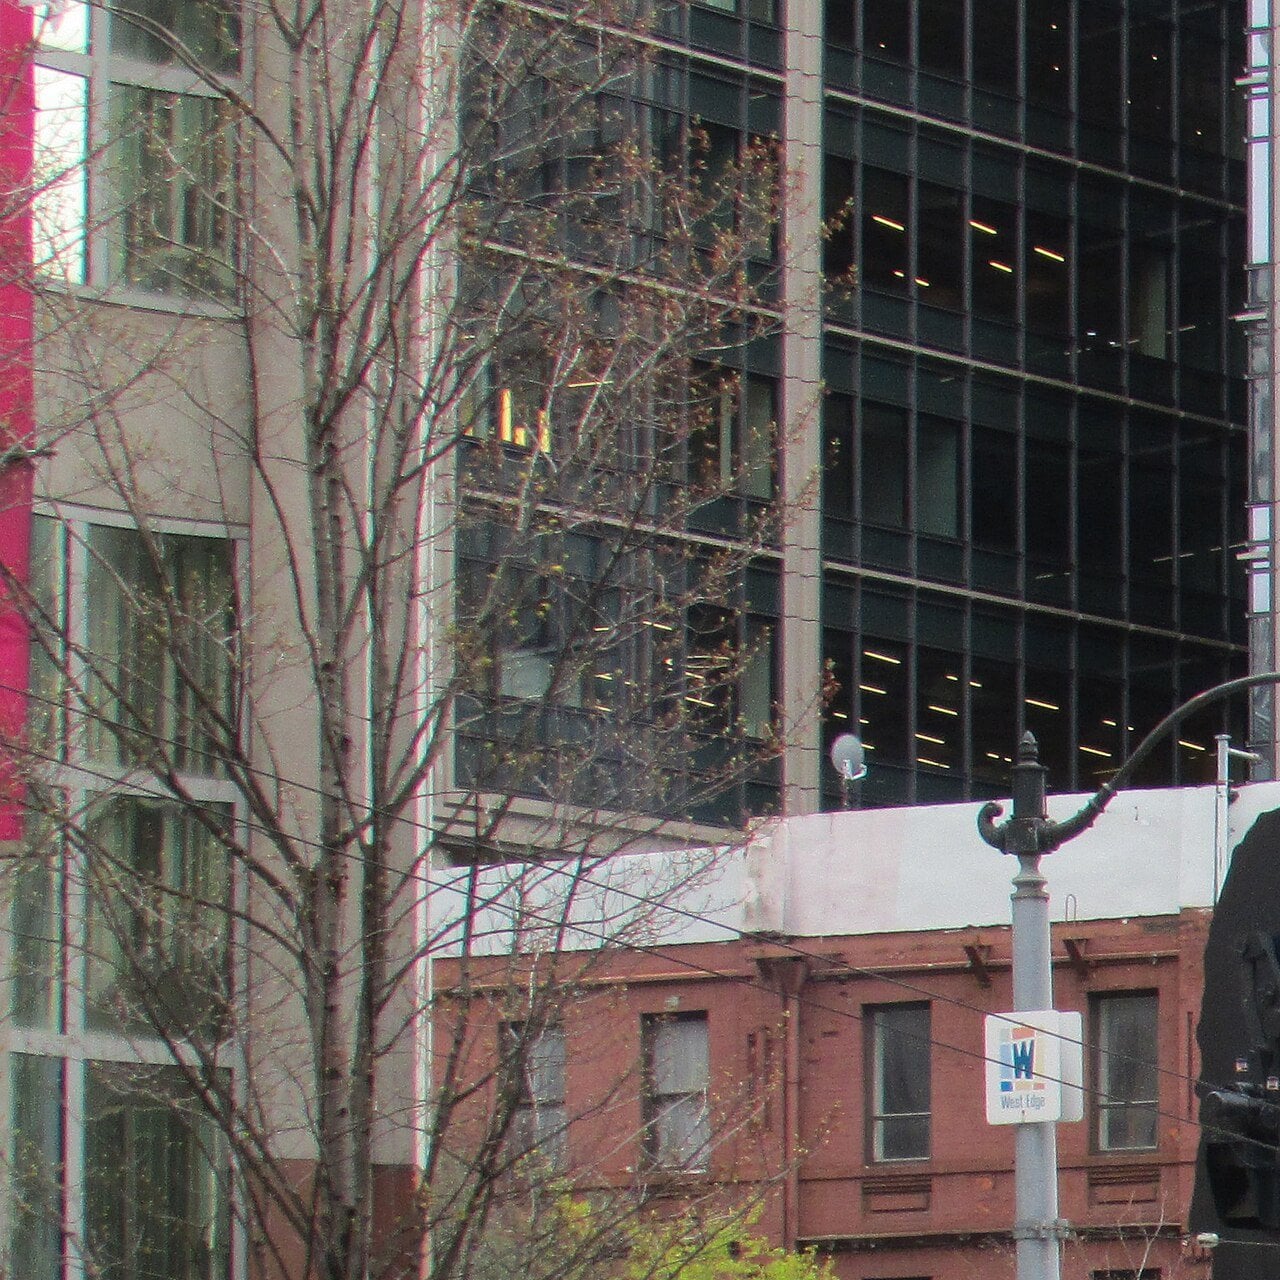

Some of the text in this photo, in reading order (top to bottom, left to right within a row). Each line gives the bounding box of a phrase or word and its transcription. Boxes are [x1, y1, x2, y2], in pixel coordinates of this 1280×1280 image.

[1013, 1040, 1034, 1079] W
[1001, 1094, 1045, 1110] West Edge
